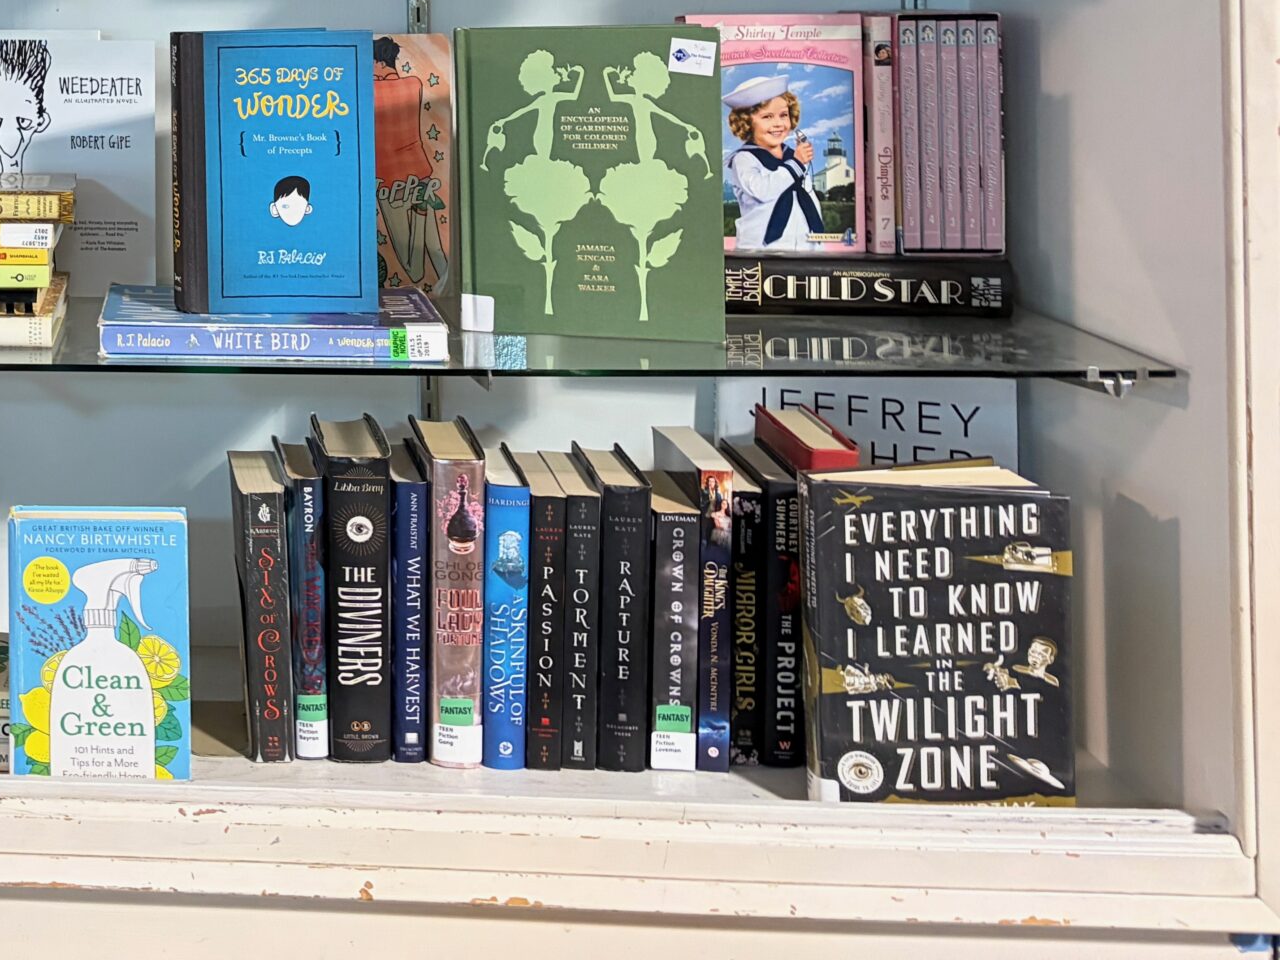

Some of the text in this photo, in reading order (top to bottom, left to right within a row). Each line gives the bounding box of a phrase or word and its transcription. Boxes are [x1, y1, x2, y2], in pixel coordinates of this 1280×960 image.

[735, 25, 822, 41] Shirley Temple
[59, 76, 142, 97] WEEDEATER
[235, 68, 271, 86] 365
[324, 67, 344, 82] OF
[233, 90, 350, 120] WONDER
[70, 135, 131, 150] ROBERT GIPE
[764, 274, 964, 306] CHILD STAR
[212, 332, 310, 351] WHITE BIRD
[392, 330, 400, 358] GRAPHIC
[399, 334, 407, 354] NOVEL
[843, 503, 1040, 546] EVERYTHING
[24, 534, 177, 546] NANCY BIRTWHISTLE
[342, 566, 376, 583] THE
[845, 546, 953, 584] I NEED
[889, 581, 1041, 618] TO KNOW
[338, 587, 383, 687] DIVINERS
[538, 566, 557, 688] PASSION
[570, 568, 590, 711] TORMENT
[847, 620, 1017, 659] I LEARNED
[62, 664, 143, 690] Clean
[936, 659, 953, 669] IN
[776, 641, 796, 734] PROJECT
[925, 670, 964, 692] THE
[92, 693, 115, 718] &
[441, 705, 472, 716] FANTASY
[846, 693, 1041, 742] TWILIGHT
[60, 712, 147, 737] Green
[896, 745, 999, 790] ZONE
